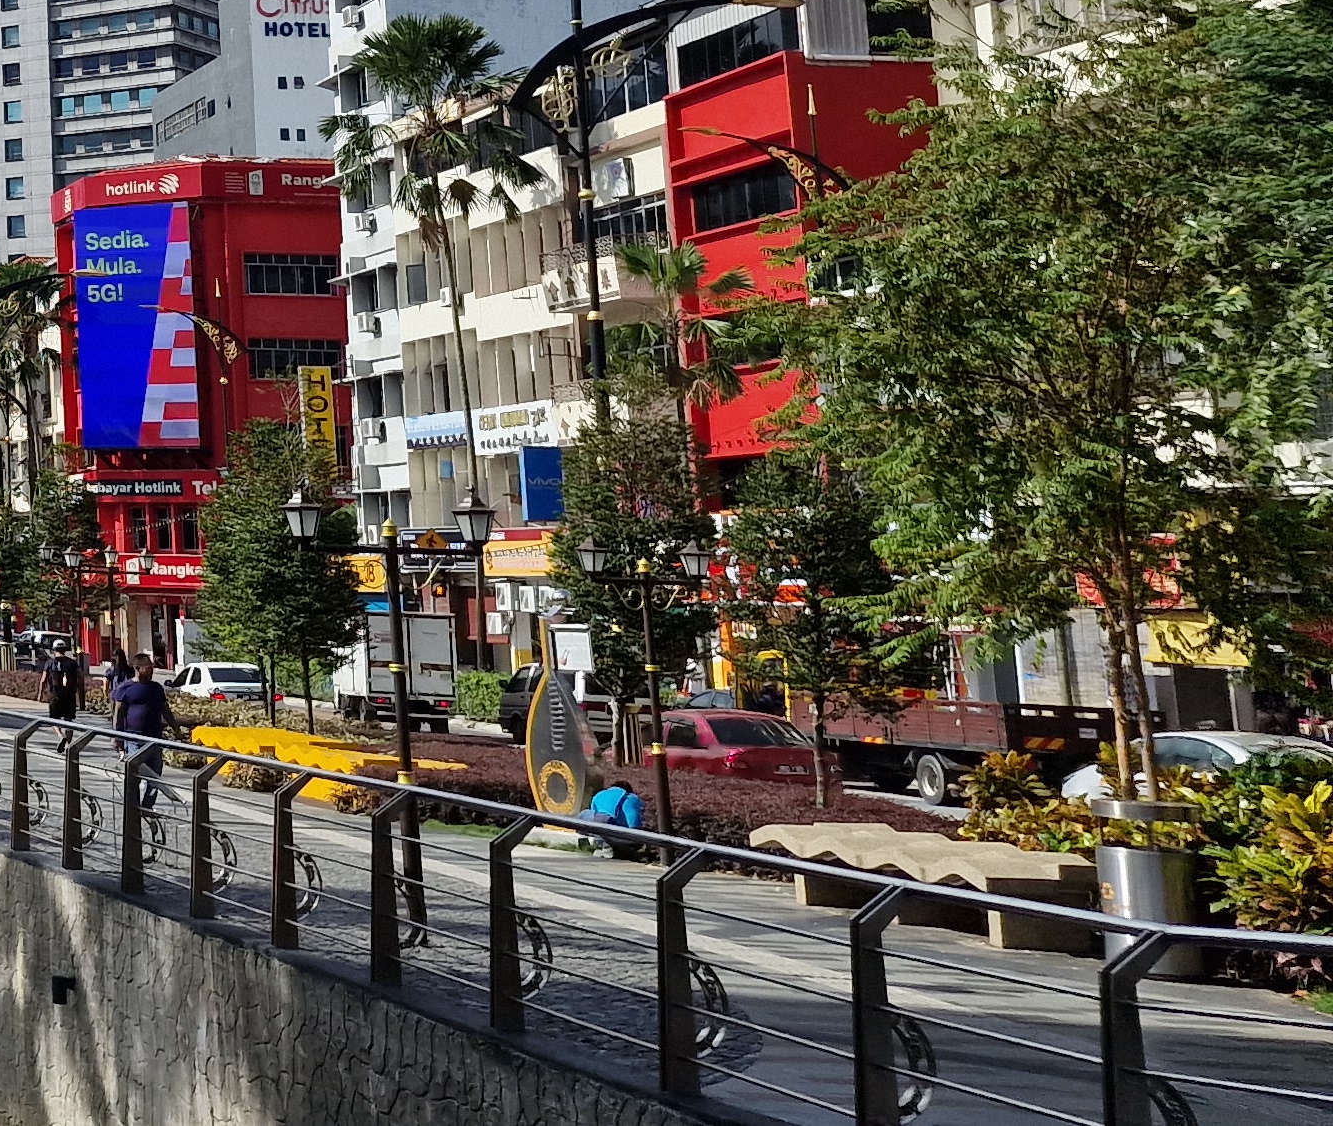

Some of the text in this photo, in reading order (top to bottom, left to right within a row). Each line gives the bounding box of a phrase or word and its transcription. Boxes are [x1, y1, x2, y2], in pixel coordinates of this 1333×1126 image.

[264, 21, 330, 38] HOTEL
[105, 179, 156, 197] hotlink
[280, 173, 326, 189] Rang
[85, 229, 150, 251] Sedia.
[86, 257, 142, 276] Mula.
[87, 283, 124, 304] 5G!
[134, 481, 182, 494] Hotlink
[528, 476, 562, 486] vivo
[150, 561, 204, 580] Rangka
